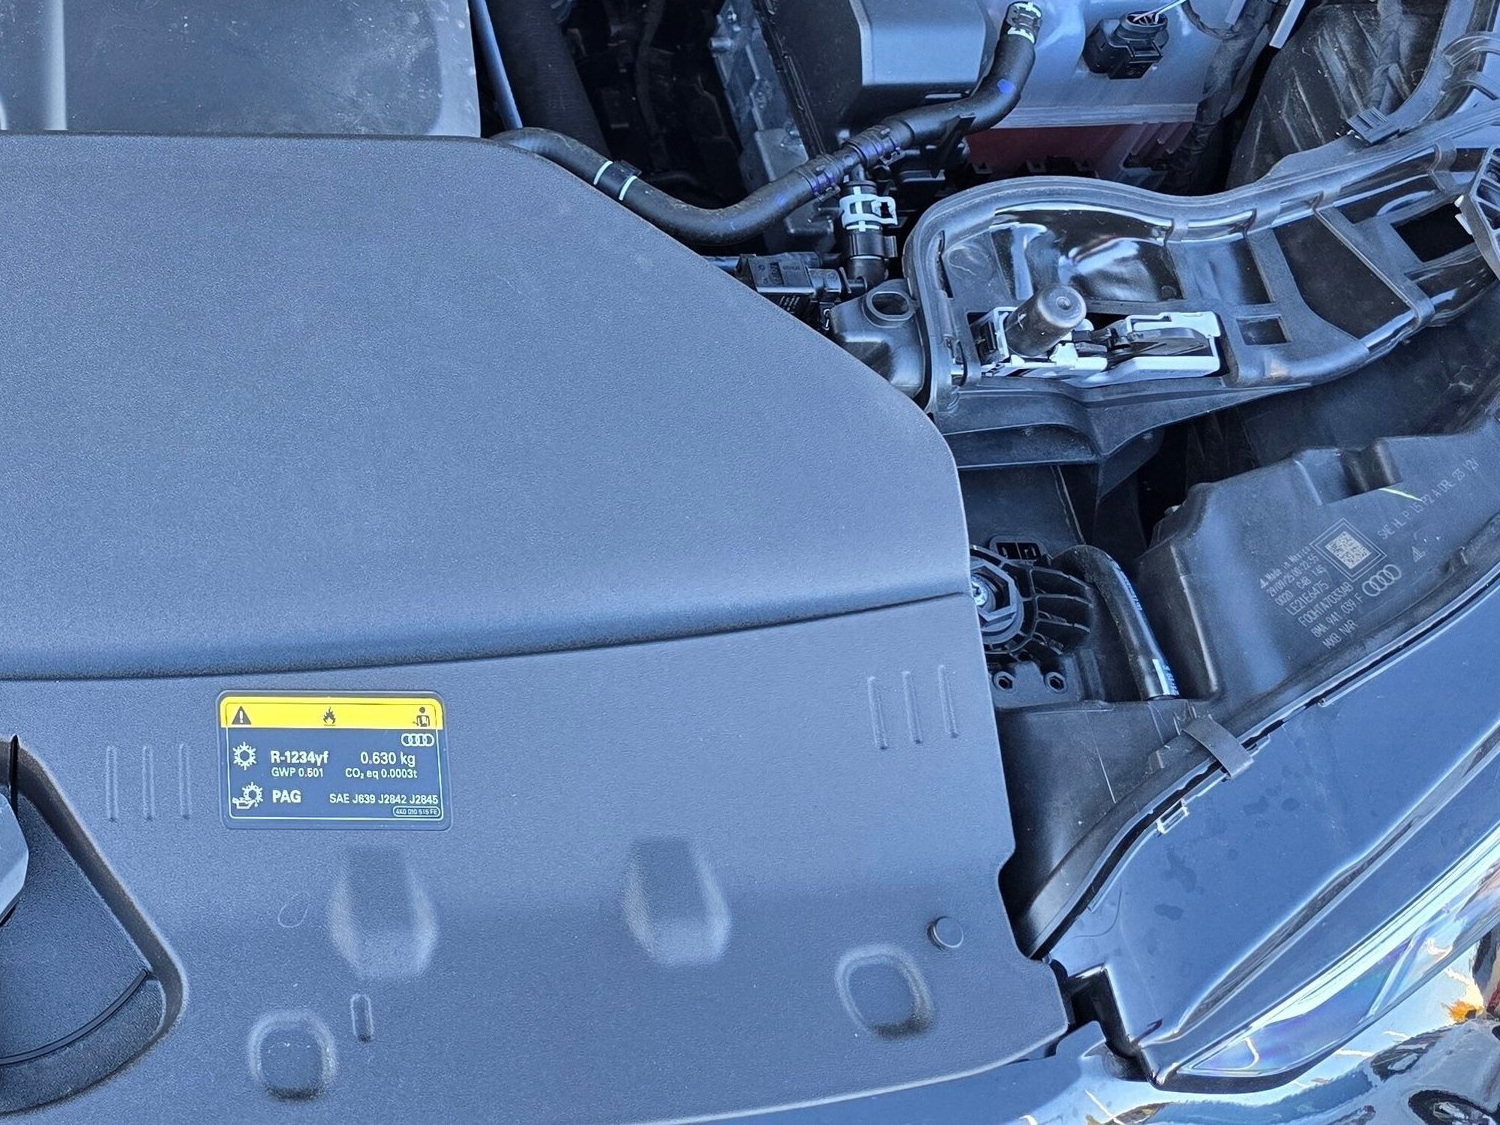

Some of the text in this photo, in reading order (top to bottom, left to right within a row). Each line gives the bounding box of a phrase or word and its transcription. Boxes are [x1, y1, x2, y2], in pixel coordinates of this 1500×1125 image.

[270, 750, 416, 767] R-1234yf 0.630 kg
[271, 768, 296, 778] GWP
[366, 770, 379, 780] eq
[272, 789, 439, 804] PAG SAE J639 J2842 J2845
